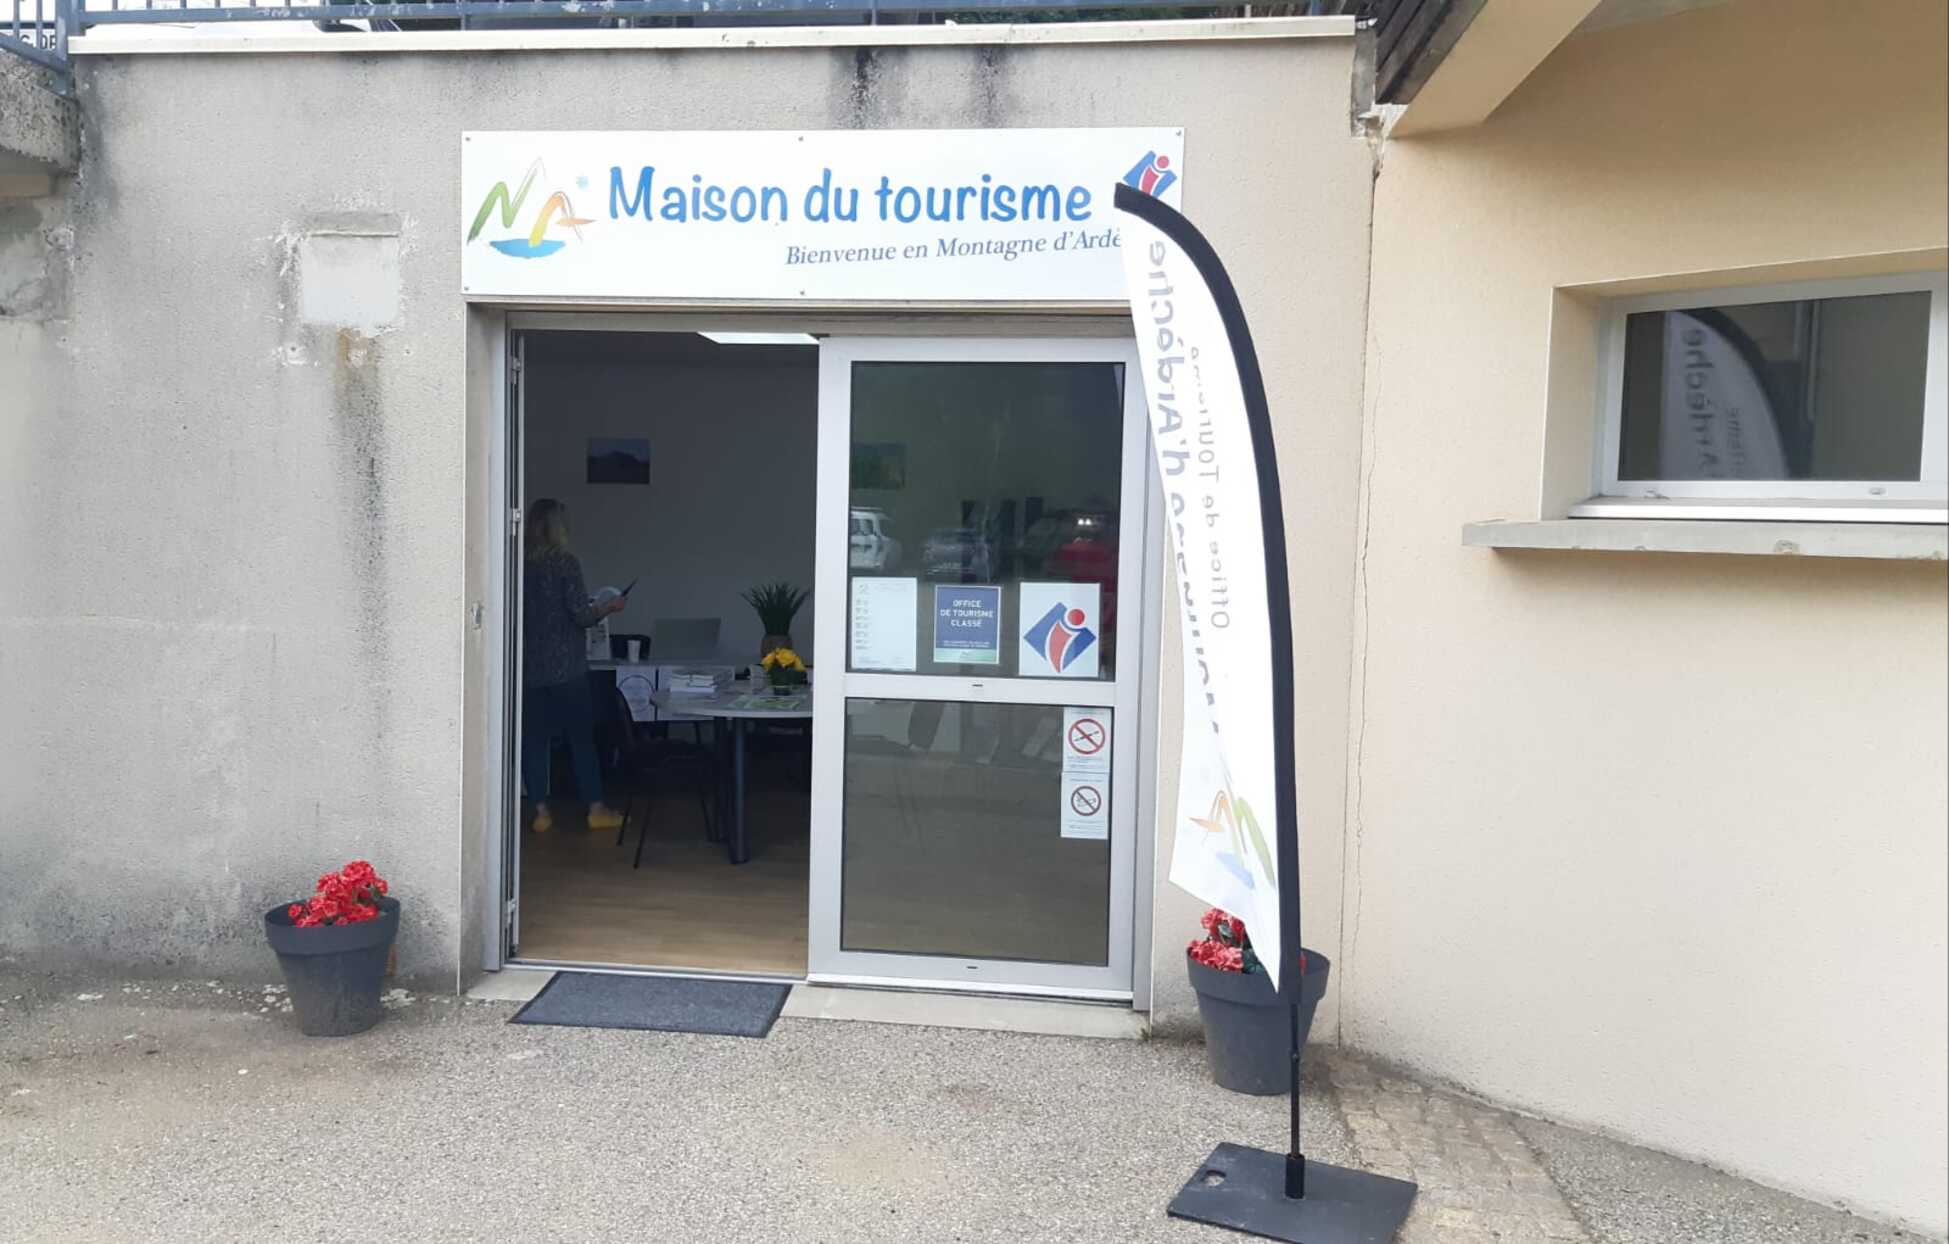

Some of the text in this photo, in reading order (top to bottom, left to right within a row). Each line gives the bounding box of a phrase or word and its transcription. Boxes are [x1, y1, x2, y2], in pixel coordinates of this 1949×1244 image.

[609, 166, 1093, 223] Maison du tourisme
[785, 228, 1121, 265] Bienvenue en Montagne d'Ardè
[940, 608, 994, 618] DE TOURISME
[952, 599, 982, 608] OFFICE
